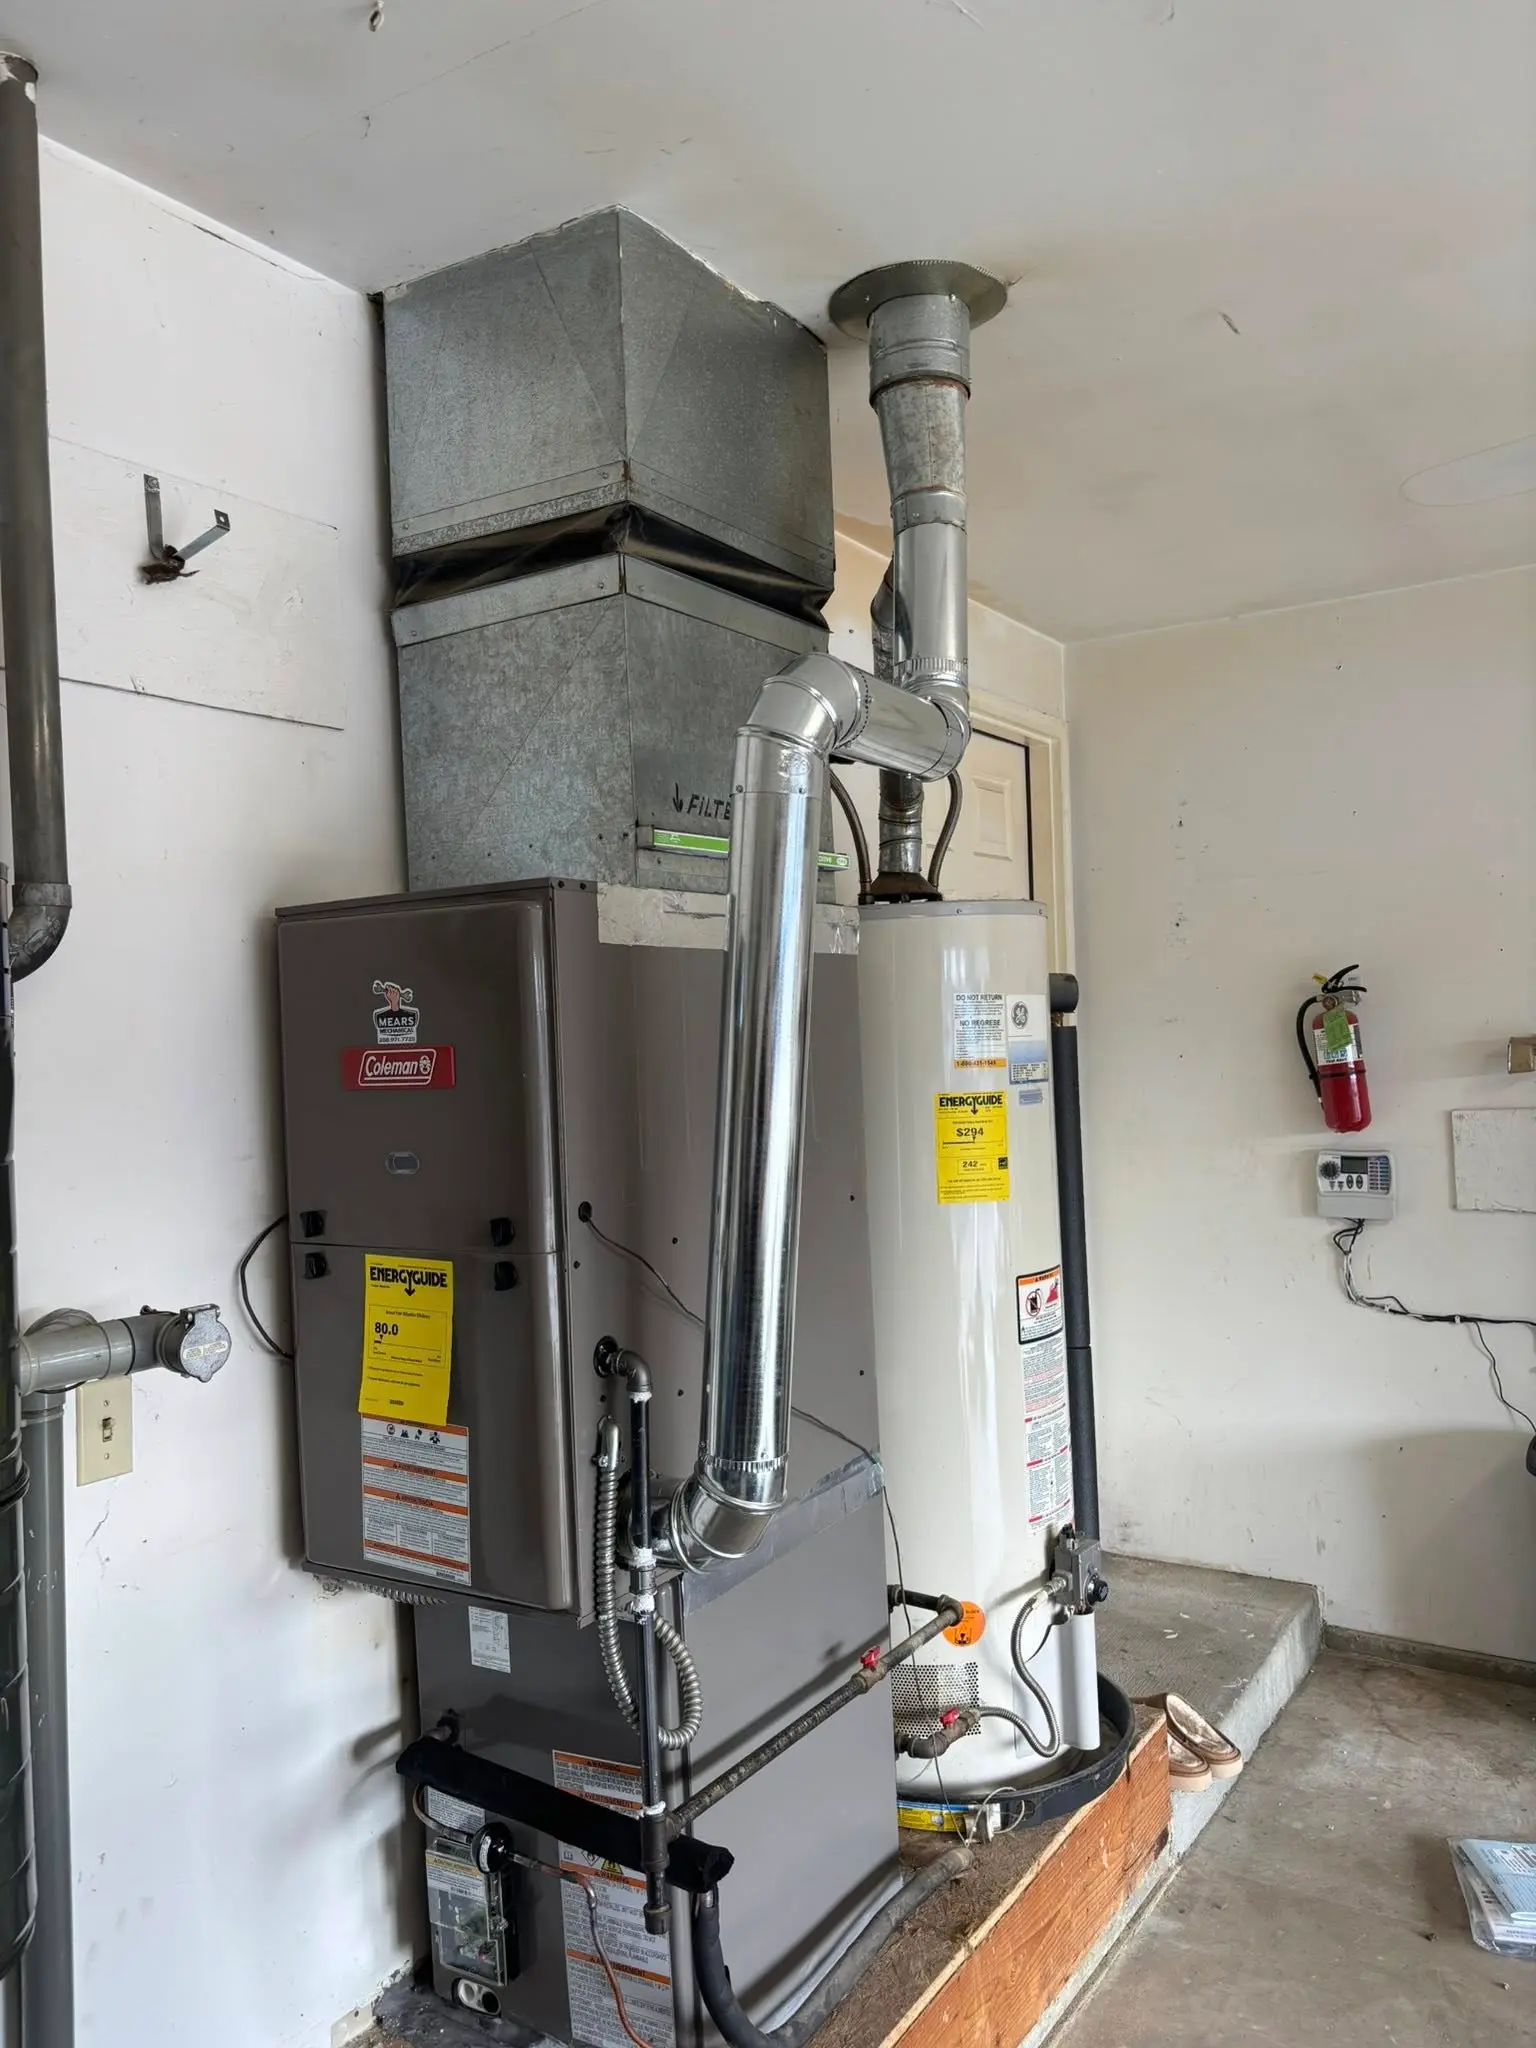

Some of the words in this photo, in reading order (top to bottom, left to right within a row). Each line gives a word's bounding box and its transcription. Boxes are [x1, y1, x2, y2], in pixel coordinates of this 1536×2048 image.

[379, 1016, 414, 1027] MEARS
[366, 1055, 418, 1077] Coleman
[939, 1095, 1003, 1108] ENERGYGUIDE
[956, 1127, 984, 1137] $294
[370, 1266, 448, 1288] ENERGYGUIDE
[374, 1321, 399, 1336] 80.0
